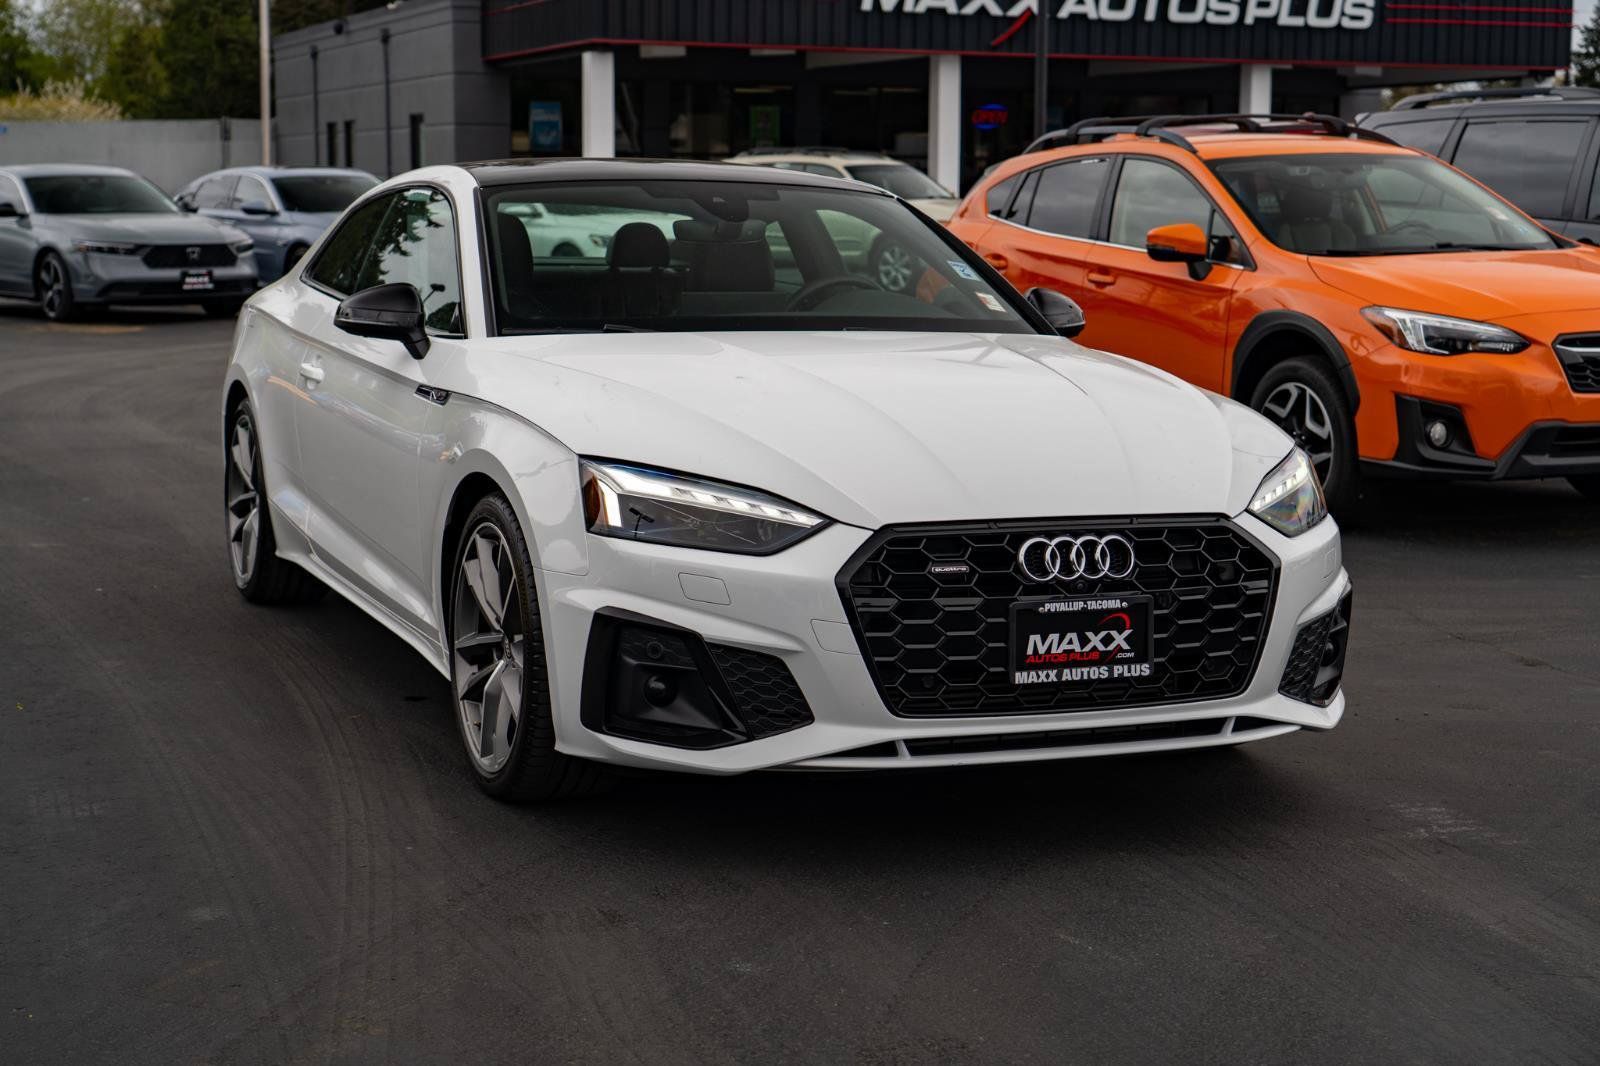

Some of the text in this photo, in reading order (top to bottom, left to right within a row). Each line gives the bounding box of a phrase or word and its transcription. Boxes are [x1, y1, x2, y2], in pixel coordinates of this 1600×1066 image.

[1243, 0, 1375, 29] PLUS
[1026, 629, 1134, 655] MAXX
[1025, 651, 1100, 663] AUTOS PLUS
[1015, 663, 1151, 684] MAXX AUTOS PLUS
